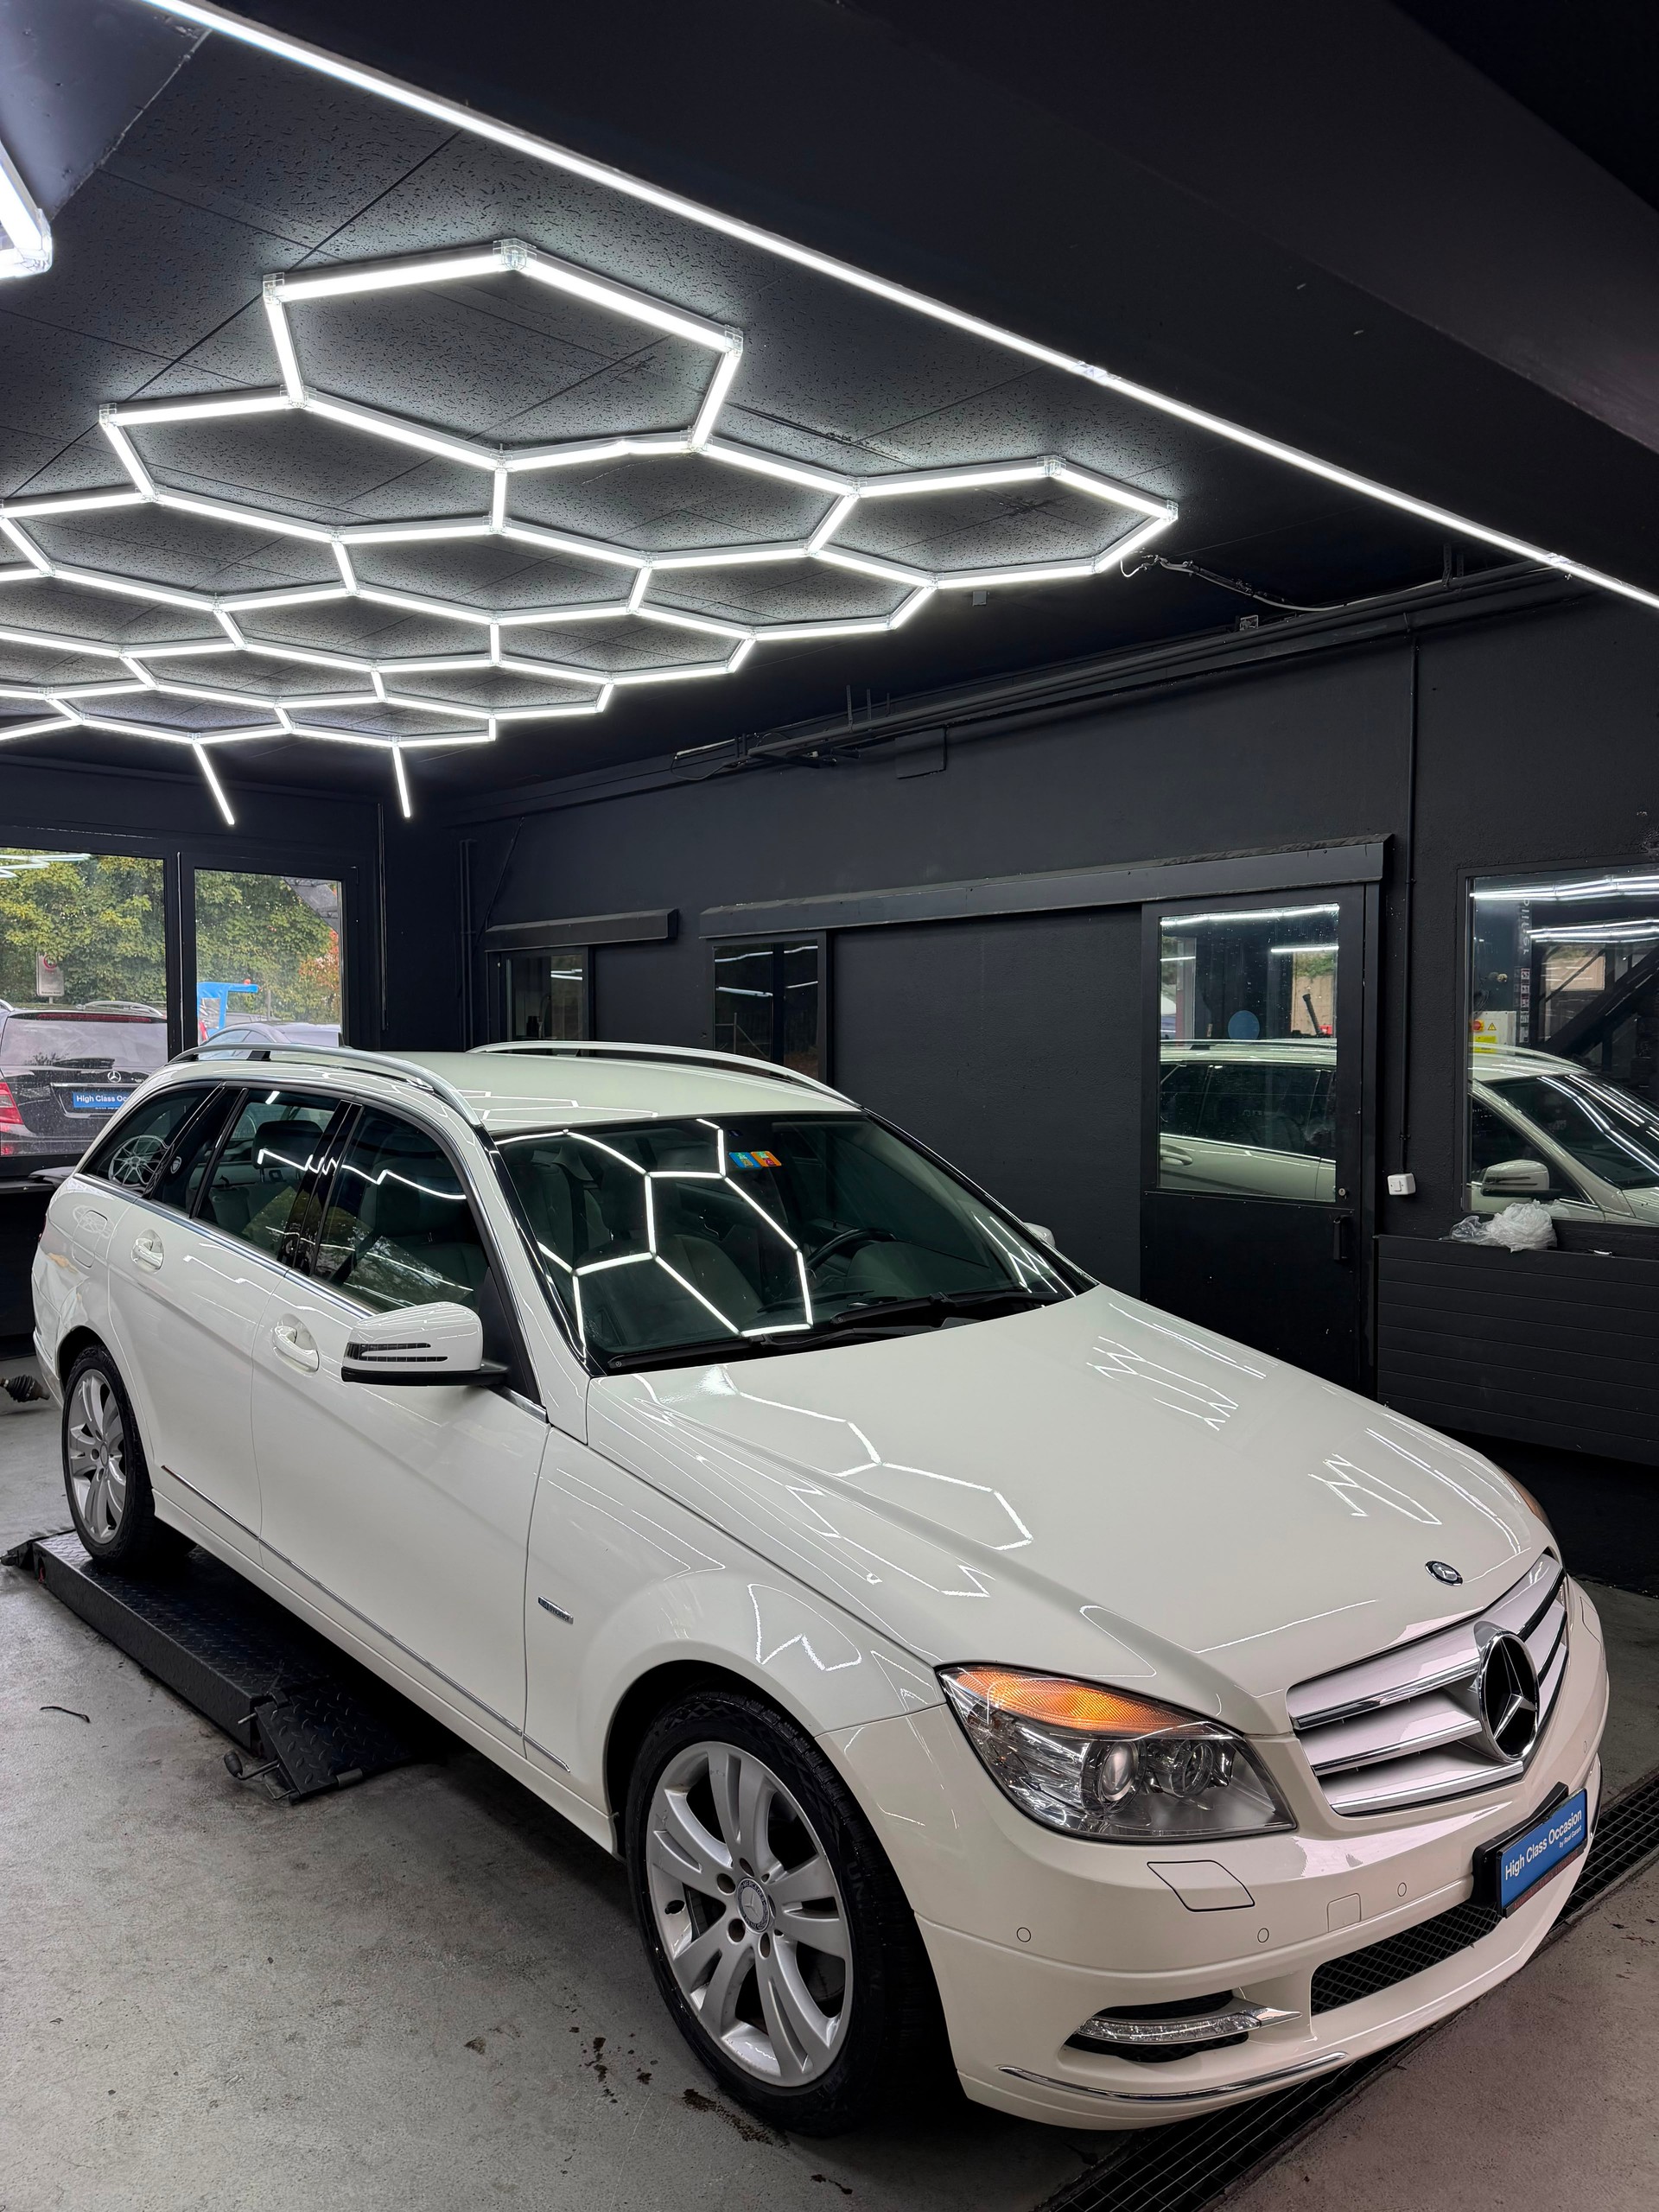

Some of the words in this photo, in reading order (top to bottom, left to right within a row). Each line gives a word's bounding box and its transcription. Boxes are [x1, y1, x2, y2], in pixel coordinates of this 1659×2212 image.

[76, 1095, 94, 1103] High
[1505, 1853, 1524, 1880] High
[1526, 1838, 1547, 1863] Class
[1548, 1809, 1582, 1845] Occasion
